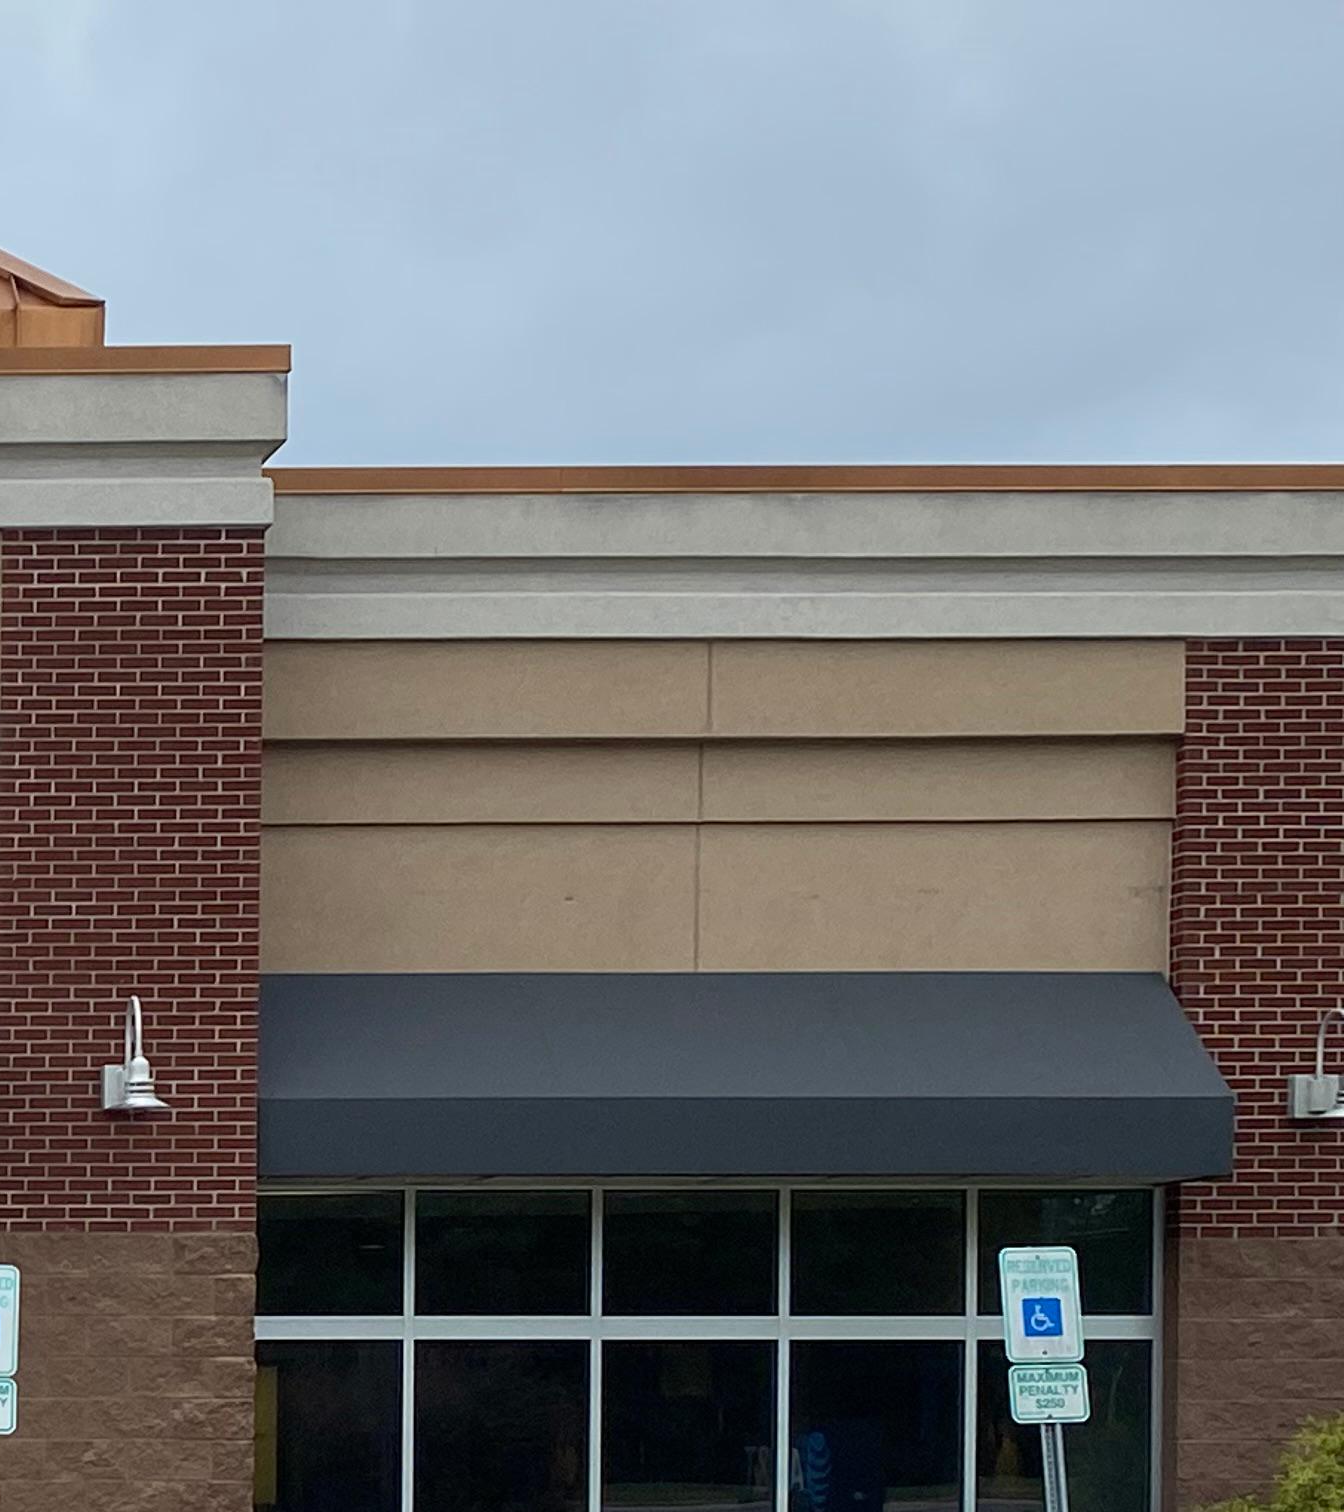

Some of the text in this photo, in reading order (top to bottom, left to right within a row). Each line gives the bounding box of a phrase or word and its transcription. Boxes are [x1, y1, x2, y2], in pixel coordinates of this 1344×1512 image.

[1013, 1278, 1070, 1293] PARKING
[1017, 1371, 1080, 1384] MAXIMUM
[1019, 1384, 1079, 1397] PENALTY
